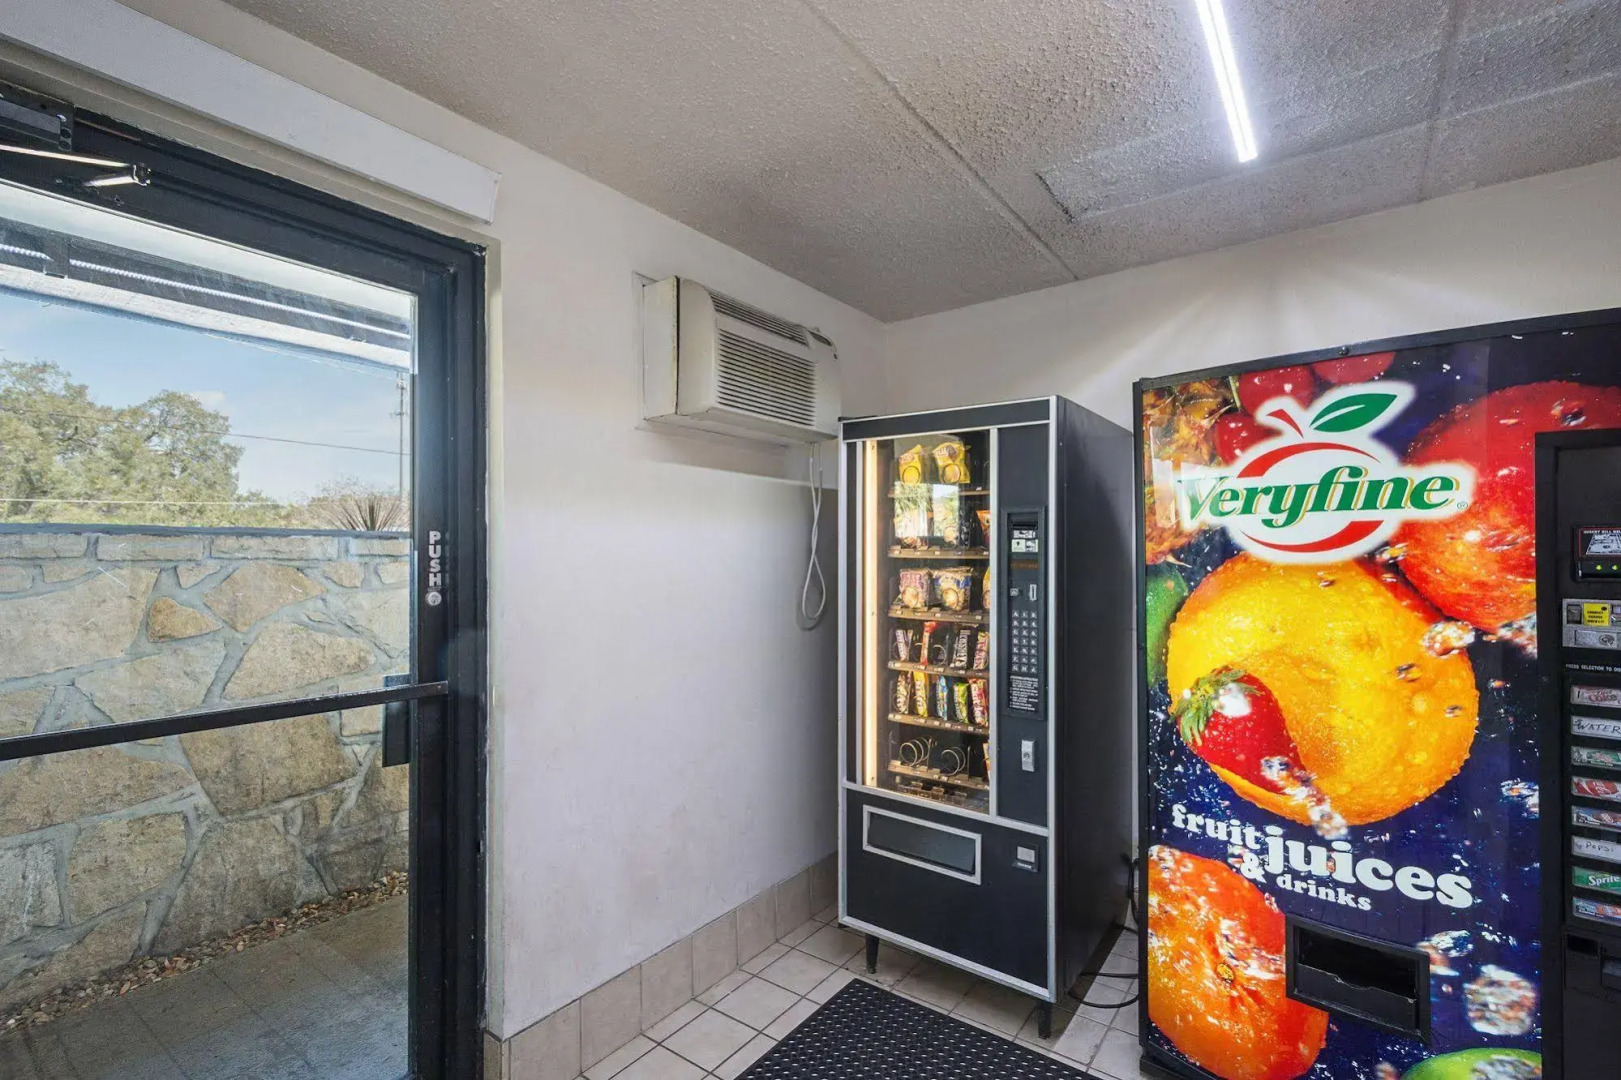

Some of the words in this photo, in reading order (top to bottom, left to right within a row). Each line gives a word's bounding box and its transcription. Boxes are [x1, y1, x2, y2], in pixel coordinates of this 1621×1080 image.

[1177, 465, 1461, 529] Veryfine
[428, 530, 442, 587] PUSH
[1576, 720, 1621, 734] WATER
[1172, 803, 1261, 850] fruit
[1240, 852, 1267, 883] &
[1264, 825, 1474, 909] juices
[1588, 875, 1620, 887] Sprite
[1276, 873, 1372, 911] drinks
